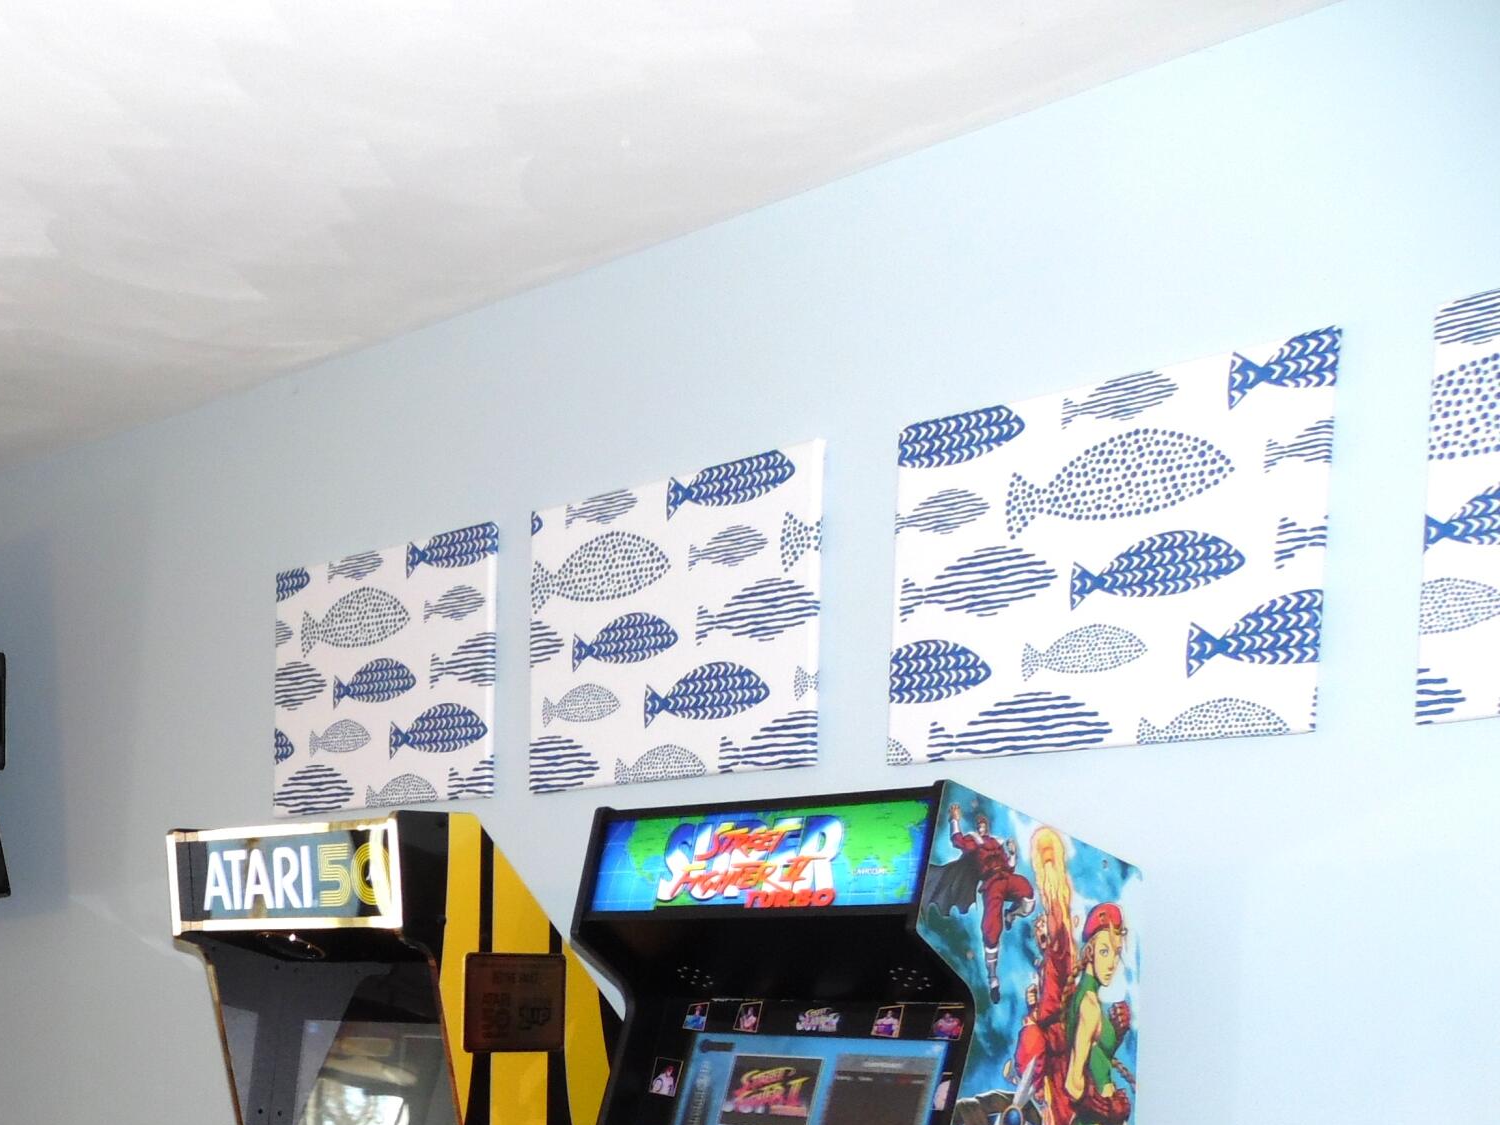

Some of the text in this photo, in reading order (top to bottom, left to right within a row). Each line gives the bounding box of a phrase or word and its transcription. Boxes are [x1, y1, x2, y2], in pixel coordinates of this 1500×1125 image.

[695, 823, 804, 861] STREET
[203, 845, 314, 911] ATARI
[670, 862, 785, 898] FIGHTER
[743, 887, 836, 909] TURBO
